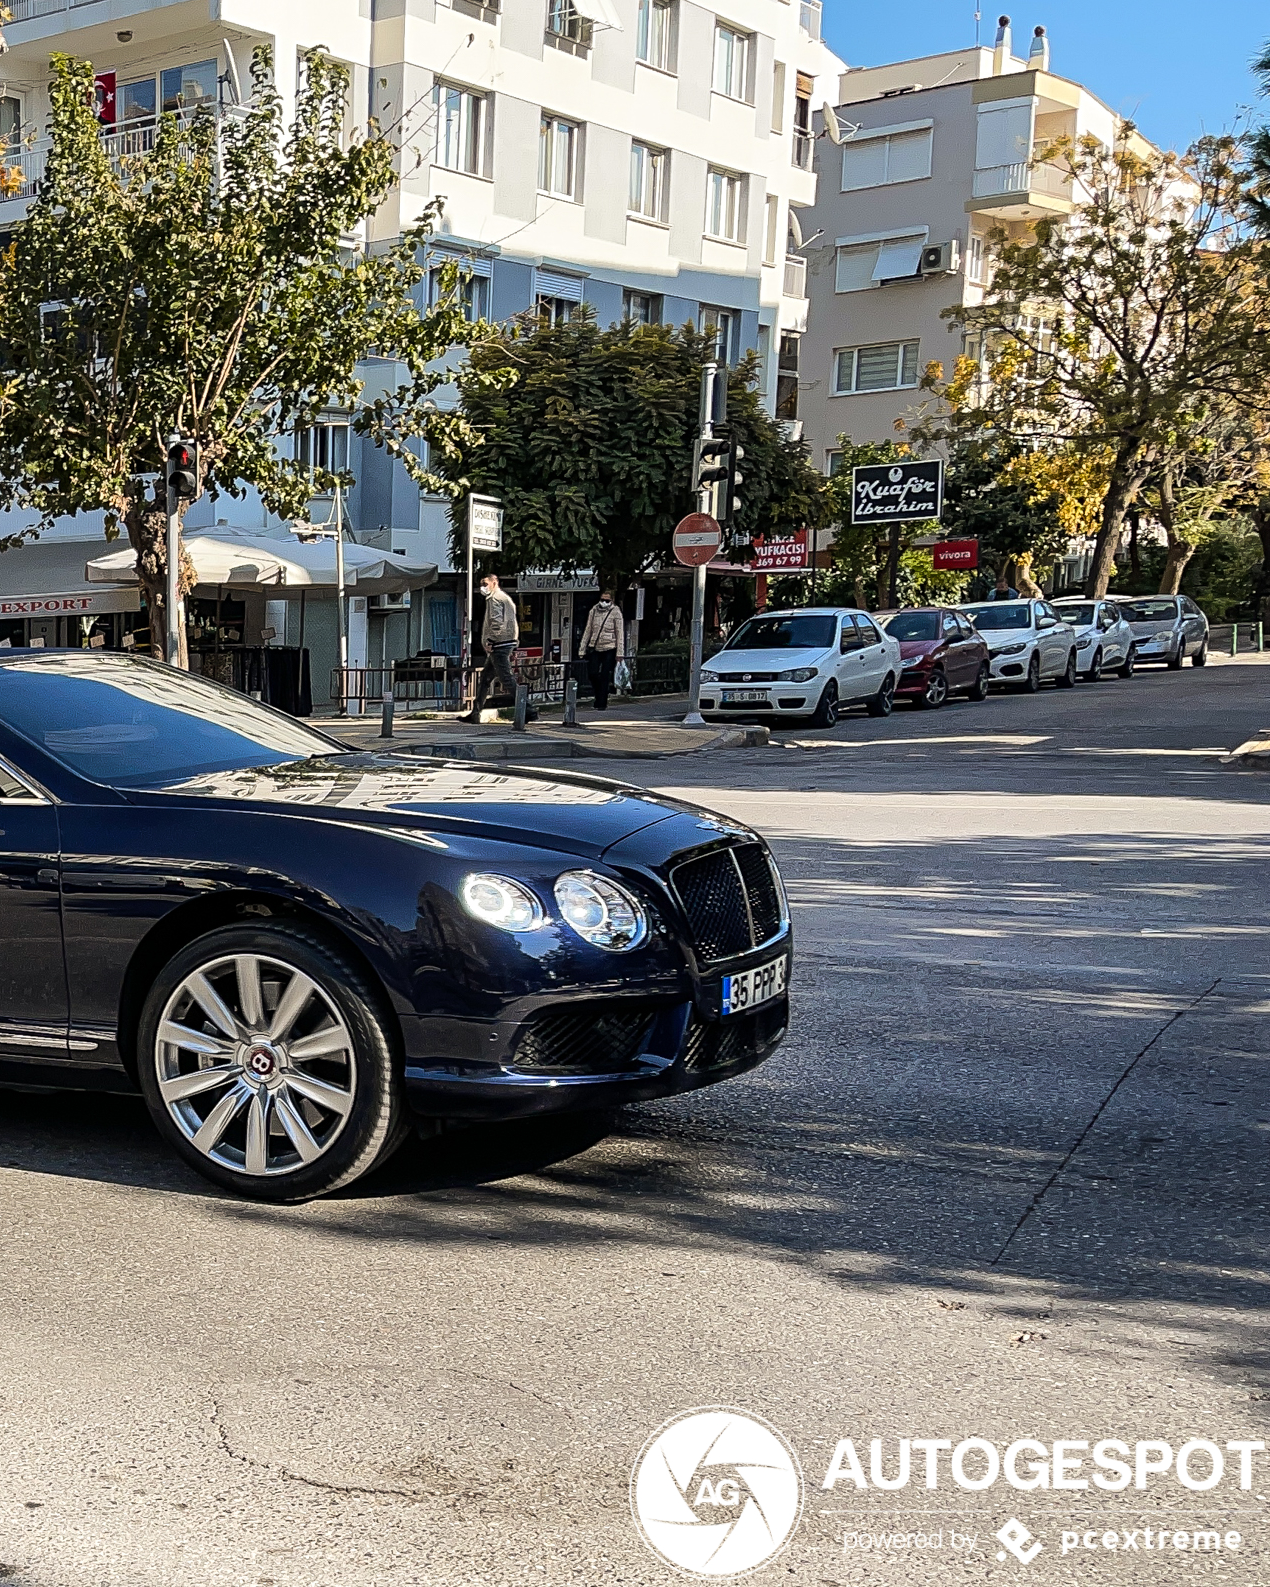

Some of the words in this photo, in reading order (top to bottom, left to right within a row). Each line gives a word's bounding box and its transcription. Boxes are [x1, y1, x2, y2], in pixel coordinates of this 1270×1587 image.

[856, 476, 936, 501] Kuaför
[775, 556, 788, 565] 67
[790, 555, 802, 564] 99
[939, 550, 971, 560] vivora
[0, 597, 93, 614] EXPORT
[730, 974, 748, 1010] 35
[752, 964, 776, 1003] PPP
